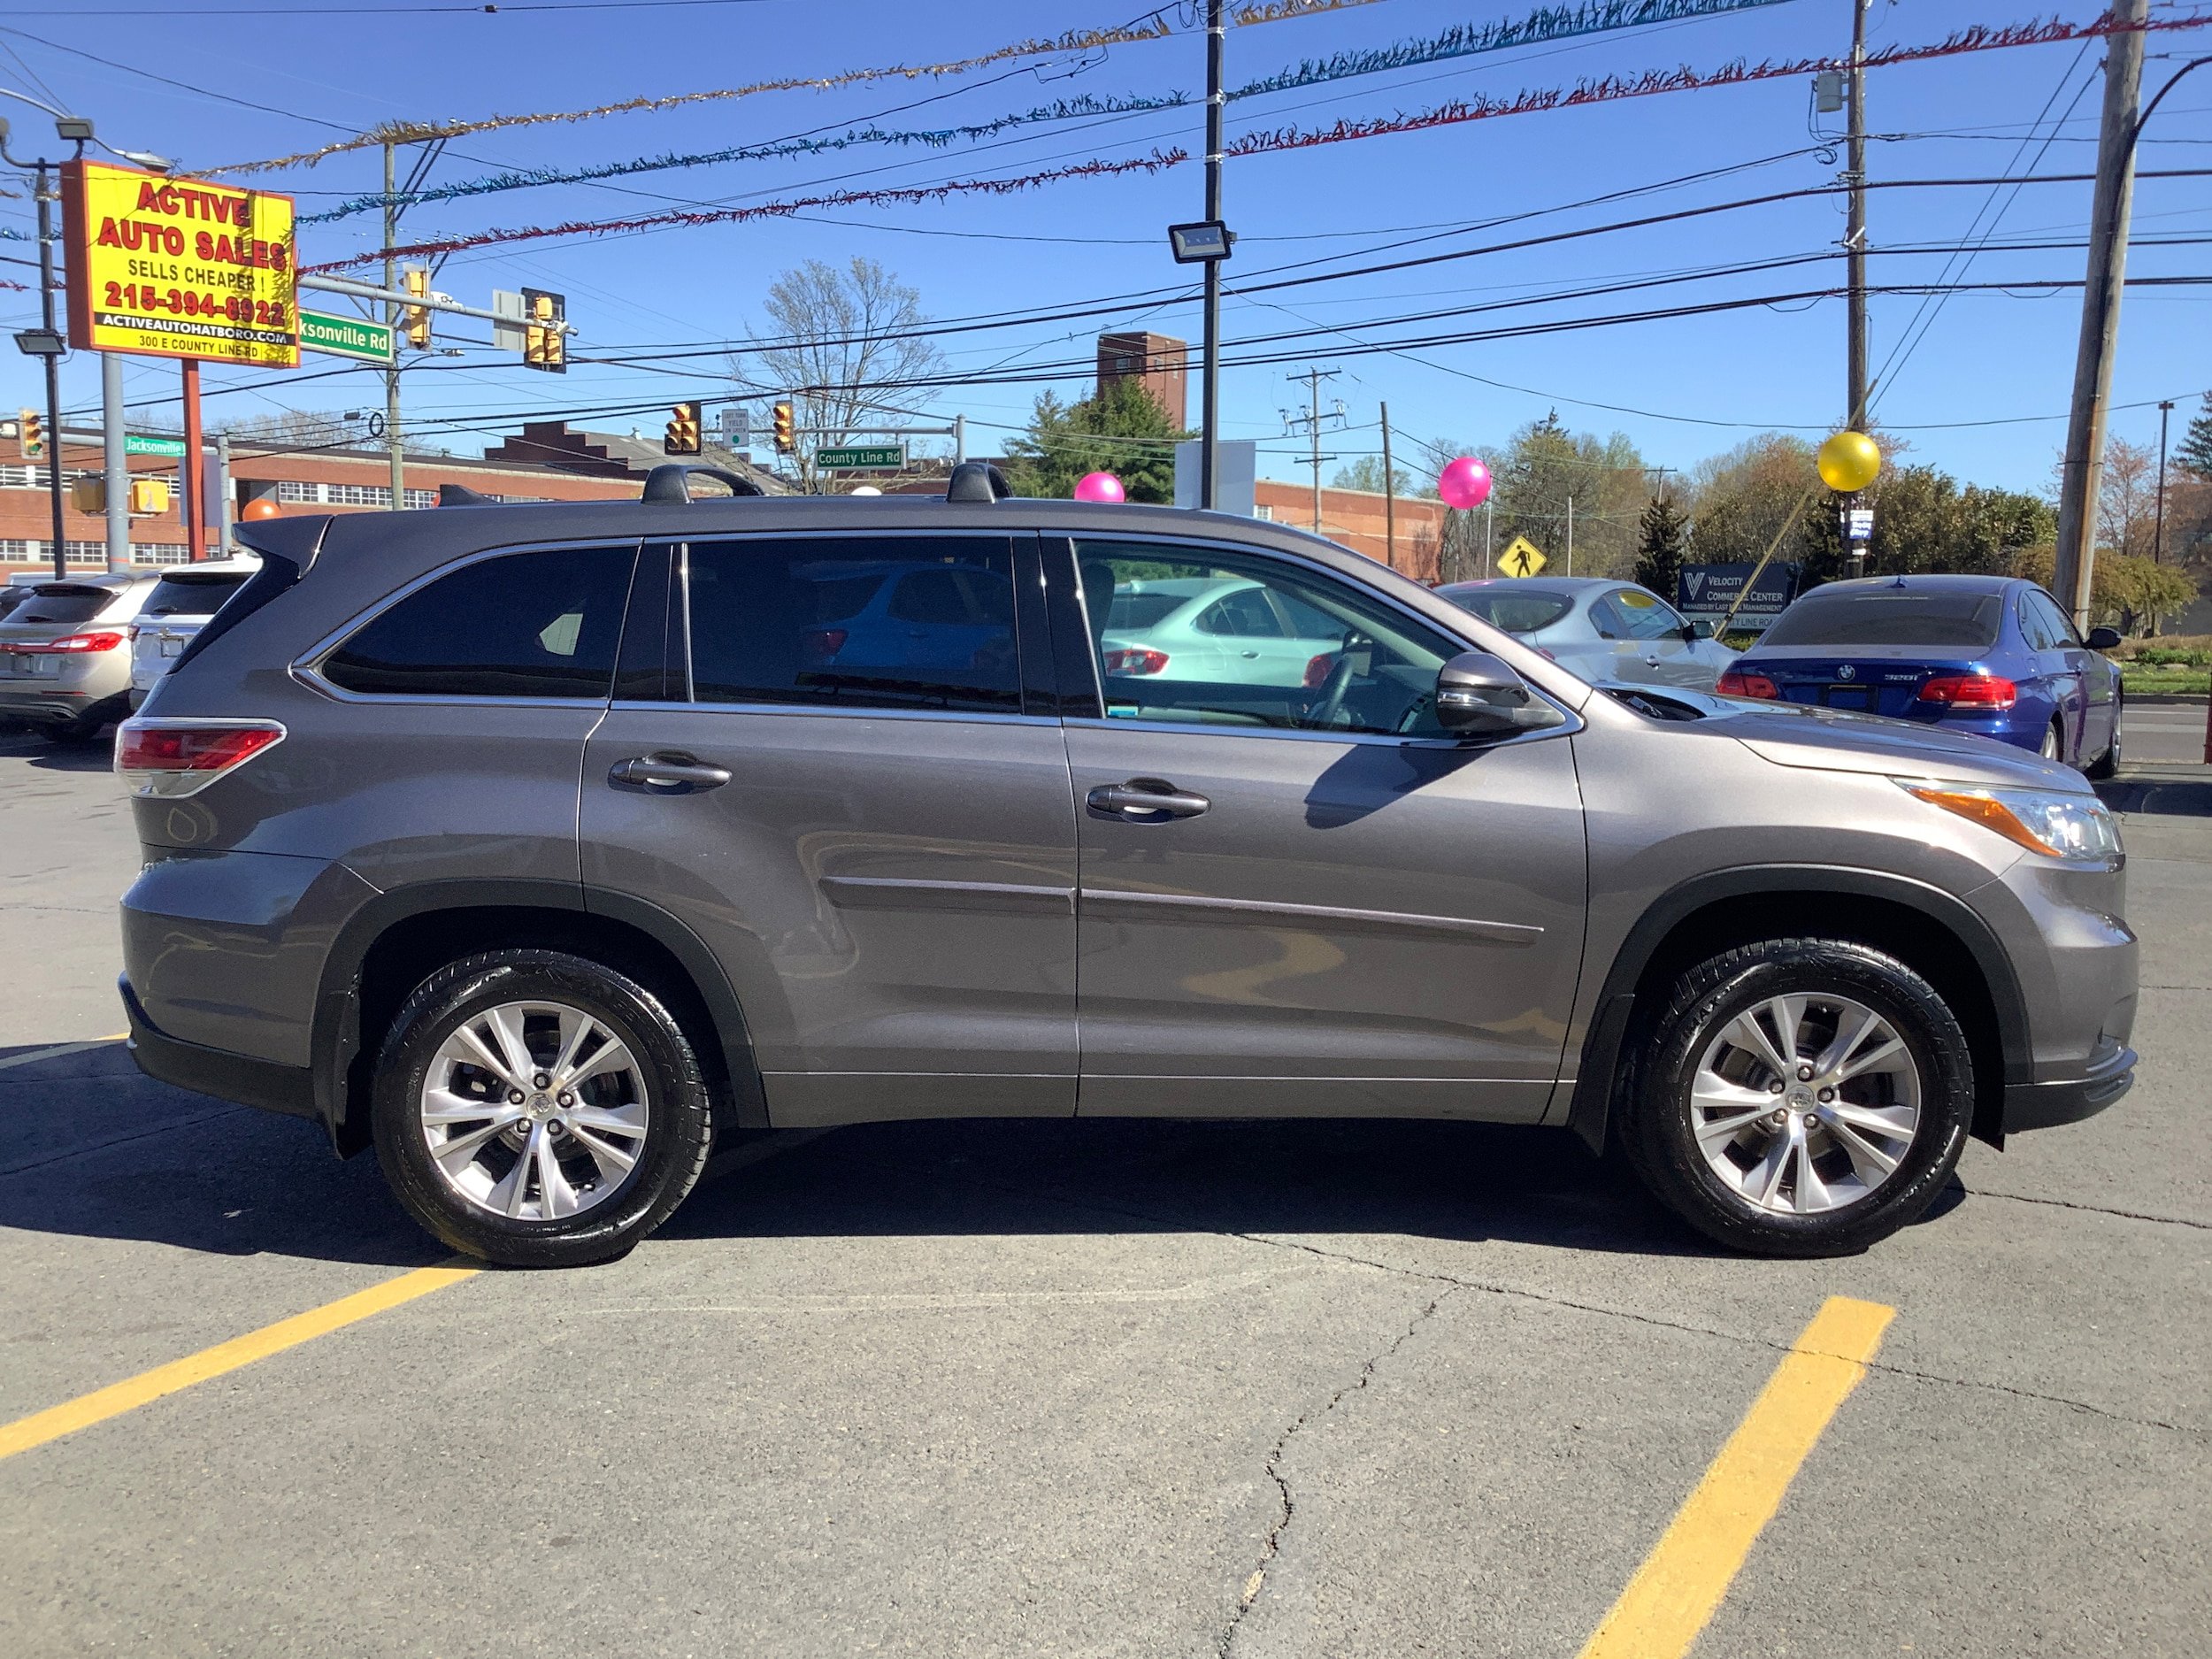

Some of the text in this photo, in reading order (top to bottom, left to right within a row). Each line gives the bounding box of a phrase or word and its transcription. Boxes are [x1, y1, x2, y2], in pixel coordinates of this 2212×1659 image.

[137, 181, 250, 227] ACTIVE
[97, 217, 287, 272] AUTO SALES
[128, 259, 178, 280] SELLS
[185, 266, 255, 292] CHEAPER
[104, 280, 285, 326] 215-394-8922
[103, 314, 287, 344] ACTIVEAUTOHATBORO.COM
[299, 319, 388, 350] ksonville Rd
[139, 335, 258, 357] 300 E COUNTY LINE RD
[127, 438, 181, 454] Jacksonville
[818, 451, 900, 466] County Line Rd
[1708, 576, 1743, 586] VELOCITY
[1707, 591, 1784, 602] COMMERE CENTER
[1741, 618, 1758, 626] LINE
